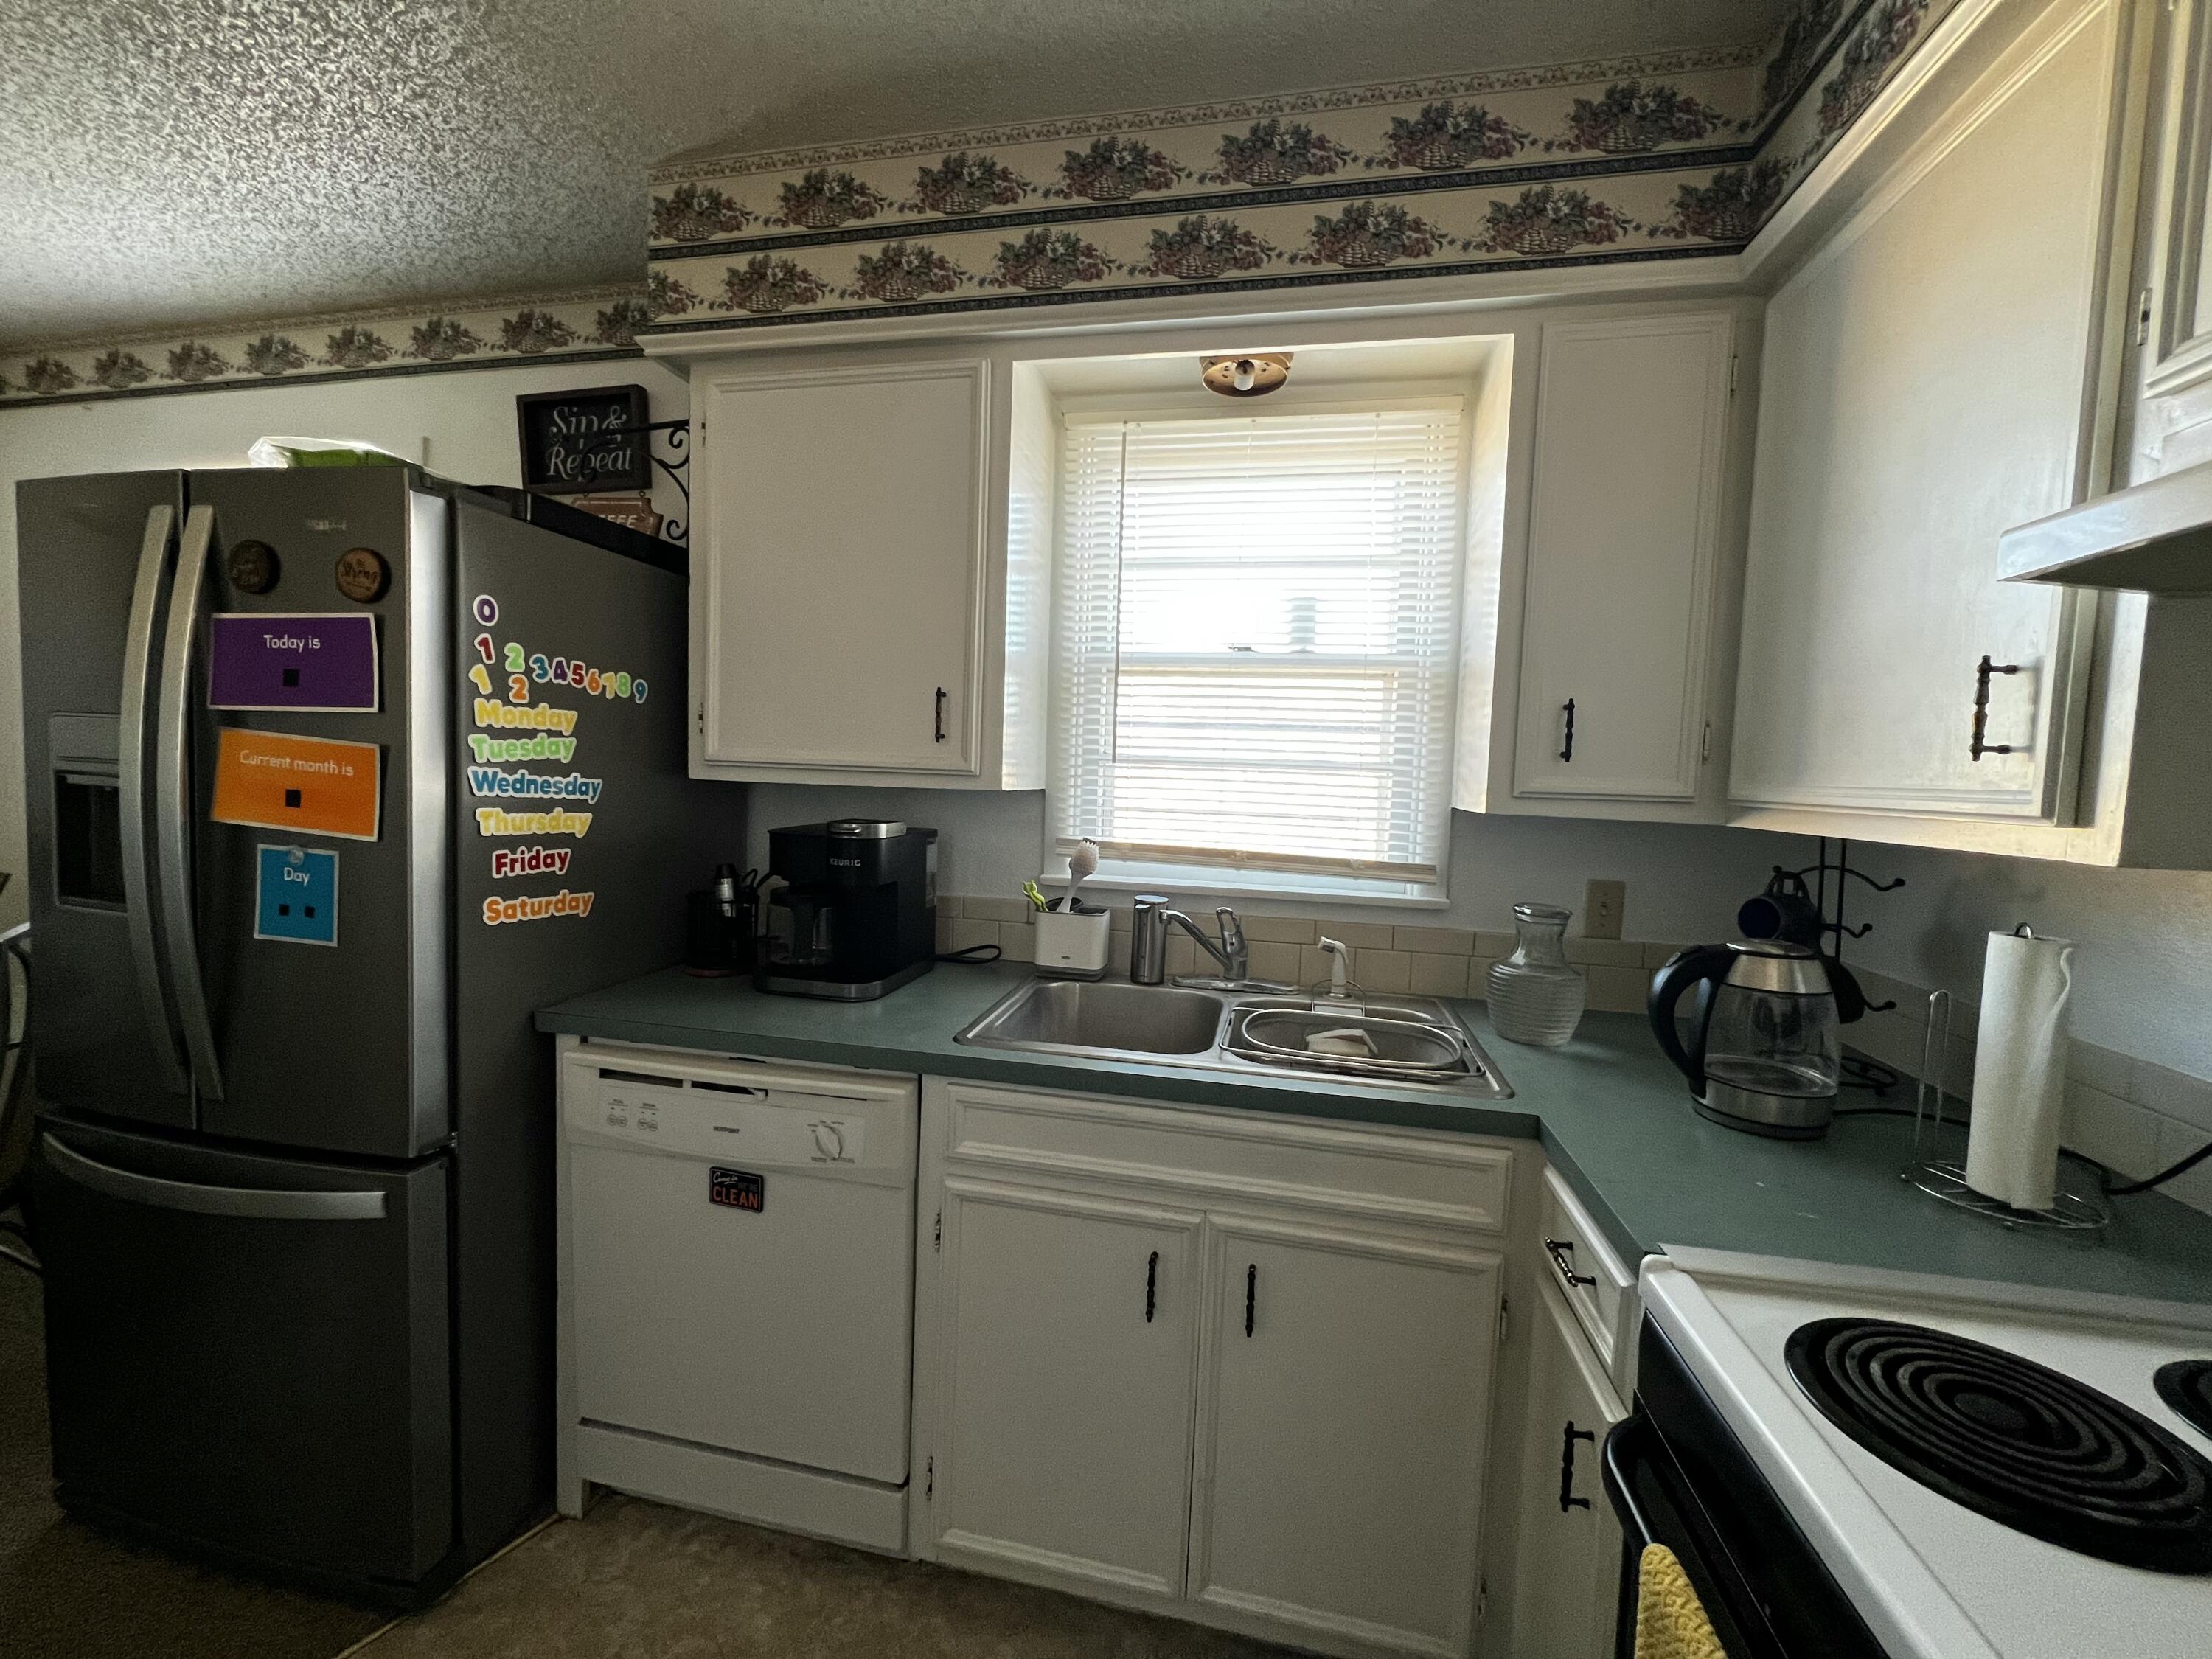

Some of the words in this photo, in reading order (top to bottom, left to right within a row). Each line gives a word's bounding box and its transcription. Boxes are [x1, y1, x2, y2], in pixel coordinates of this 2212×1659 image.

[546, 445, 633, 482] Repeat
[263, 634, 305, 653] Today
[308, 635, 321, 649] is
[476, 636, 494, 662] 1
[505, 644, 524, 671] 2
[531, 655, 549, 681] 3
[553, 658, 568, 683] 4
[571, 662, 585, 686] 5
[587, 670, 601, 694] 6
[602, 673, 614, 698] 7
[616, 674, 630, 696] 8
[634, 681, 647, 703] 9
[510, 675, 528, 701] 2
[475, 699, 577, 734] Monday
[470, 734, 576, 761] Tuesday
[240, 749, 290, 768] Current
[294, 759, 338, 775] month
[341, 762, 354, 776] is
[470, 768, 601, 802] Wednesday
[477, 809, 591, 836] Thursday
[494, 848, 570, 876] Friday
[829, 858, 861, 866] KEURIG
[283, 866, 310, 886] Day
[484, 891, 593, 923] Saturday
[713, 1186, 758, 1208] CLEAN
